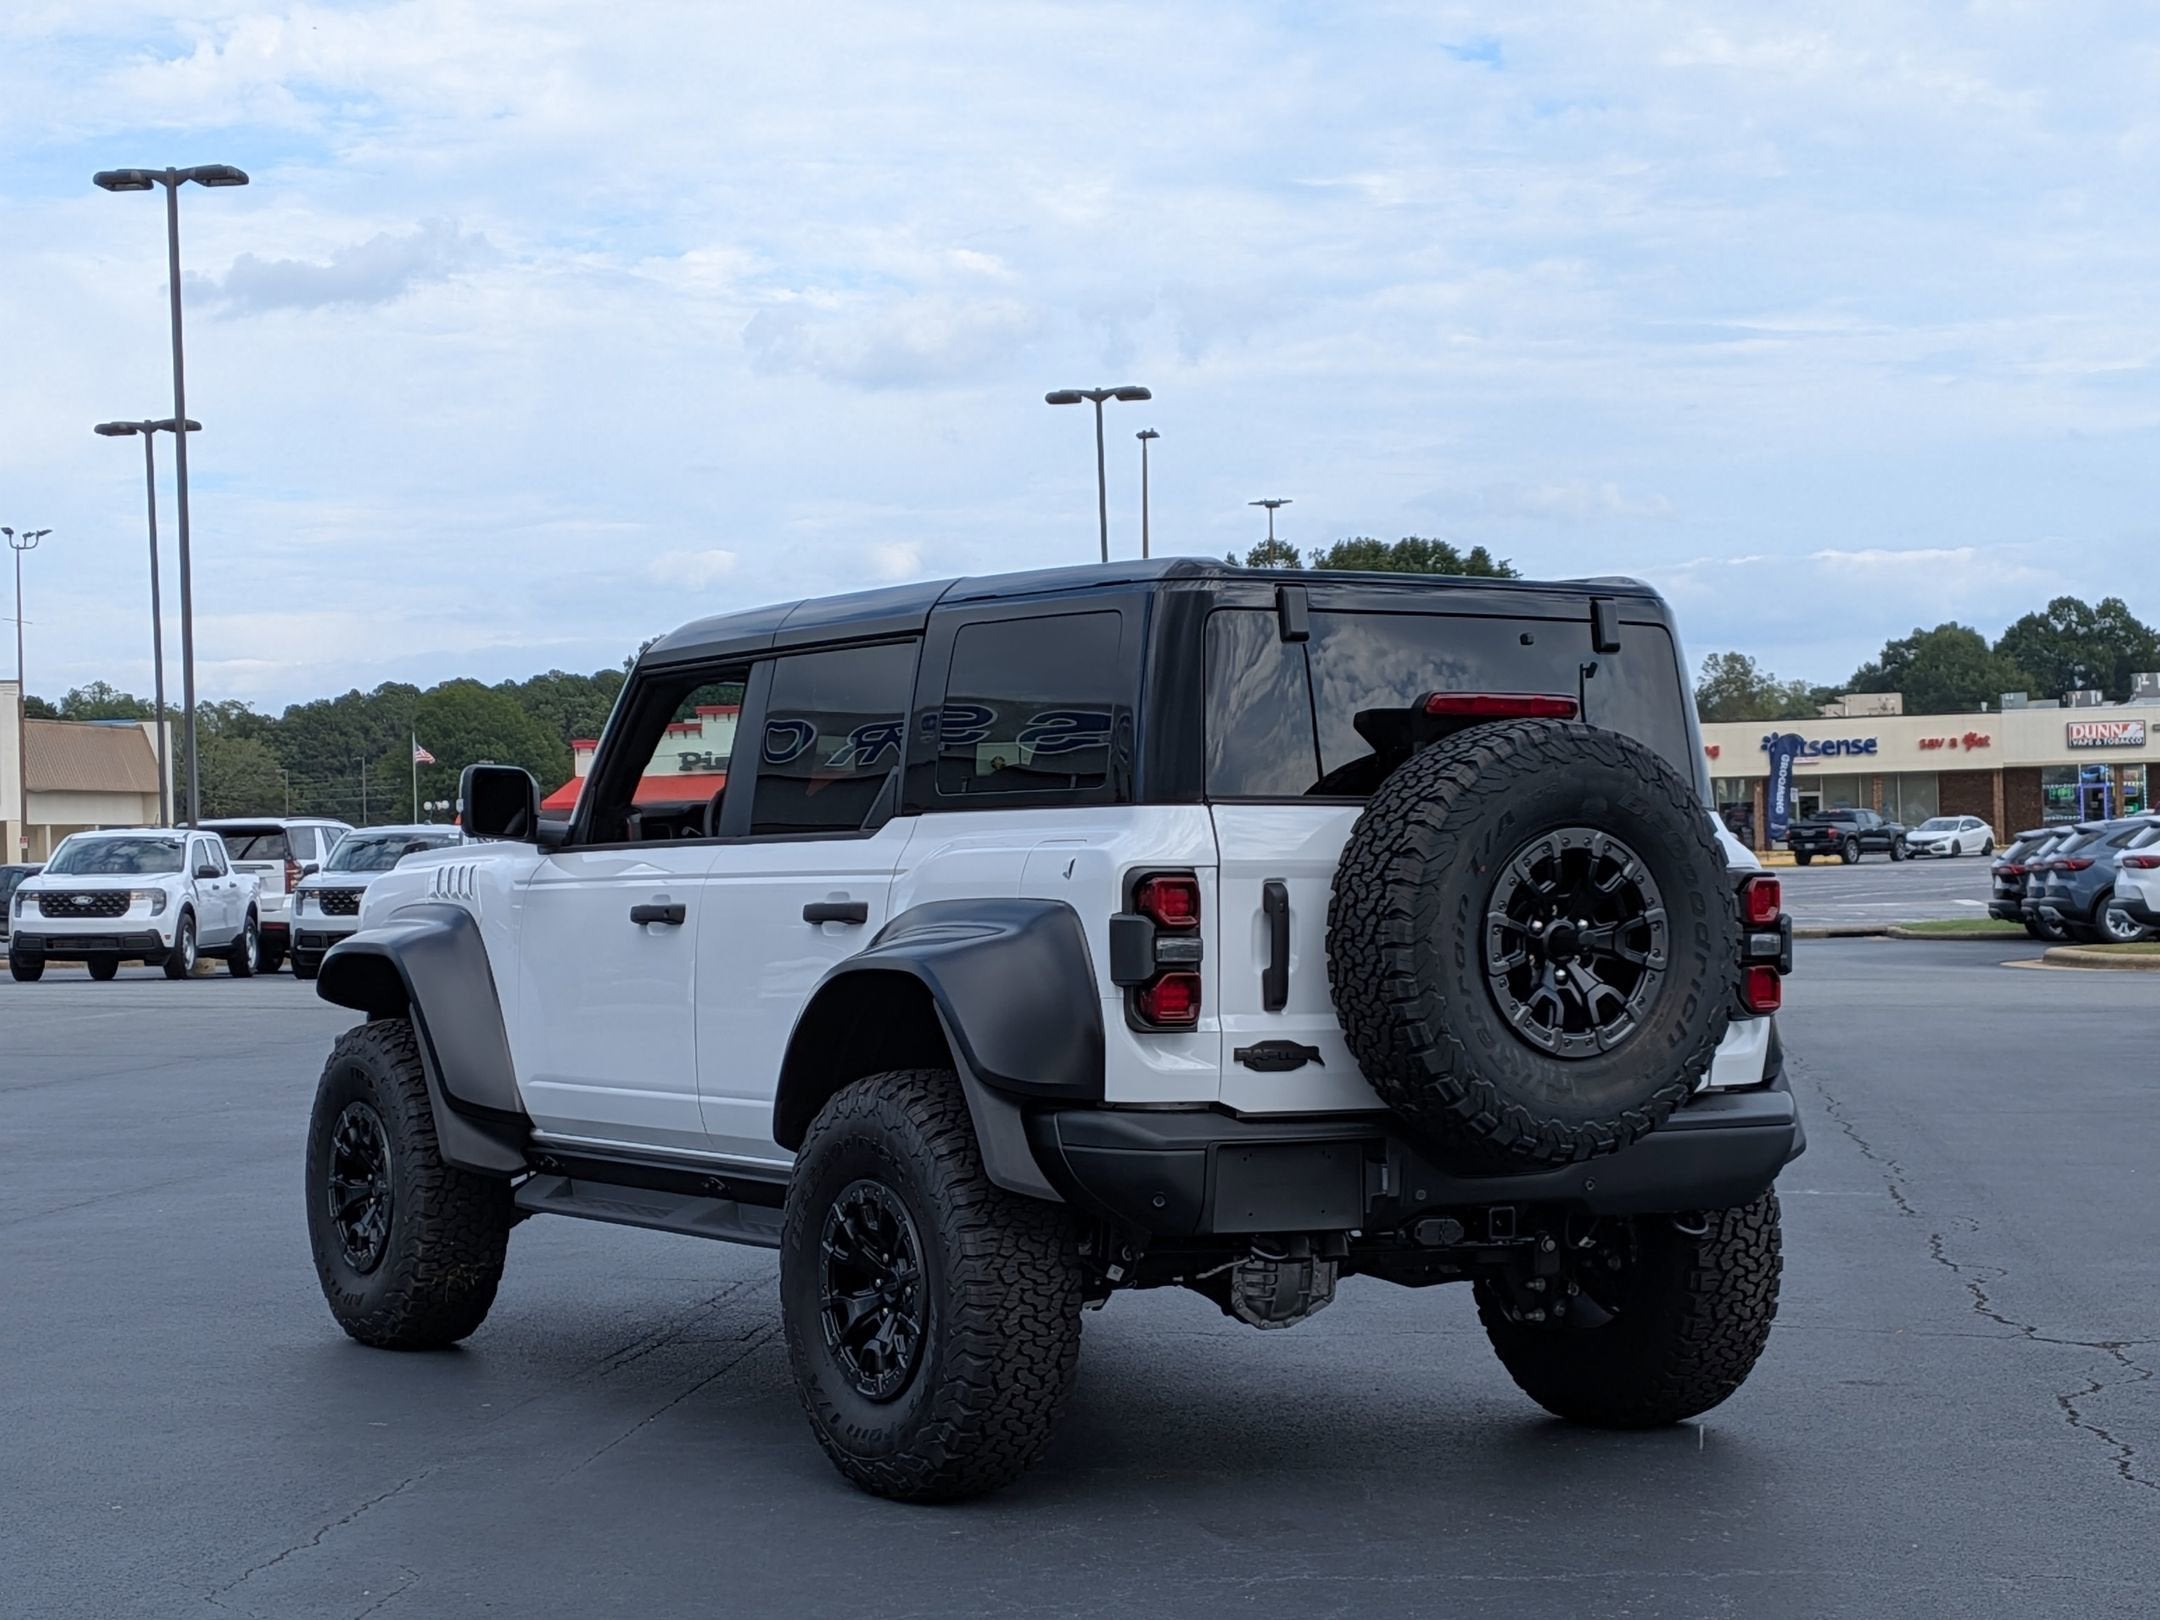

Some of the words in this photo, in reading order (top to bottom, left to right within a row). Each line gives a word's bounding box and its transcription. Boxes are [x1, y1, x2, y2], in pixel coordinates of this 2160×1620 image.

[2071, 723, 2123, 739] DUNN
[2102, 736, 2143, 746] TOBACCO
[1775, 753, 1790, 815] GROOMING
